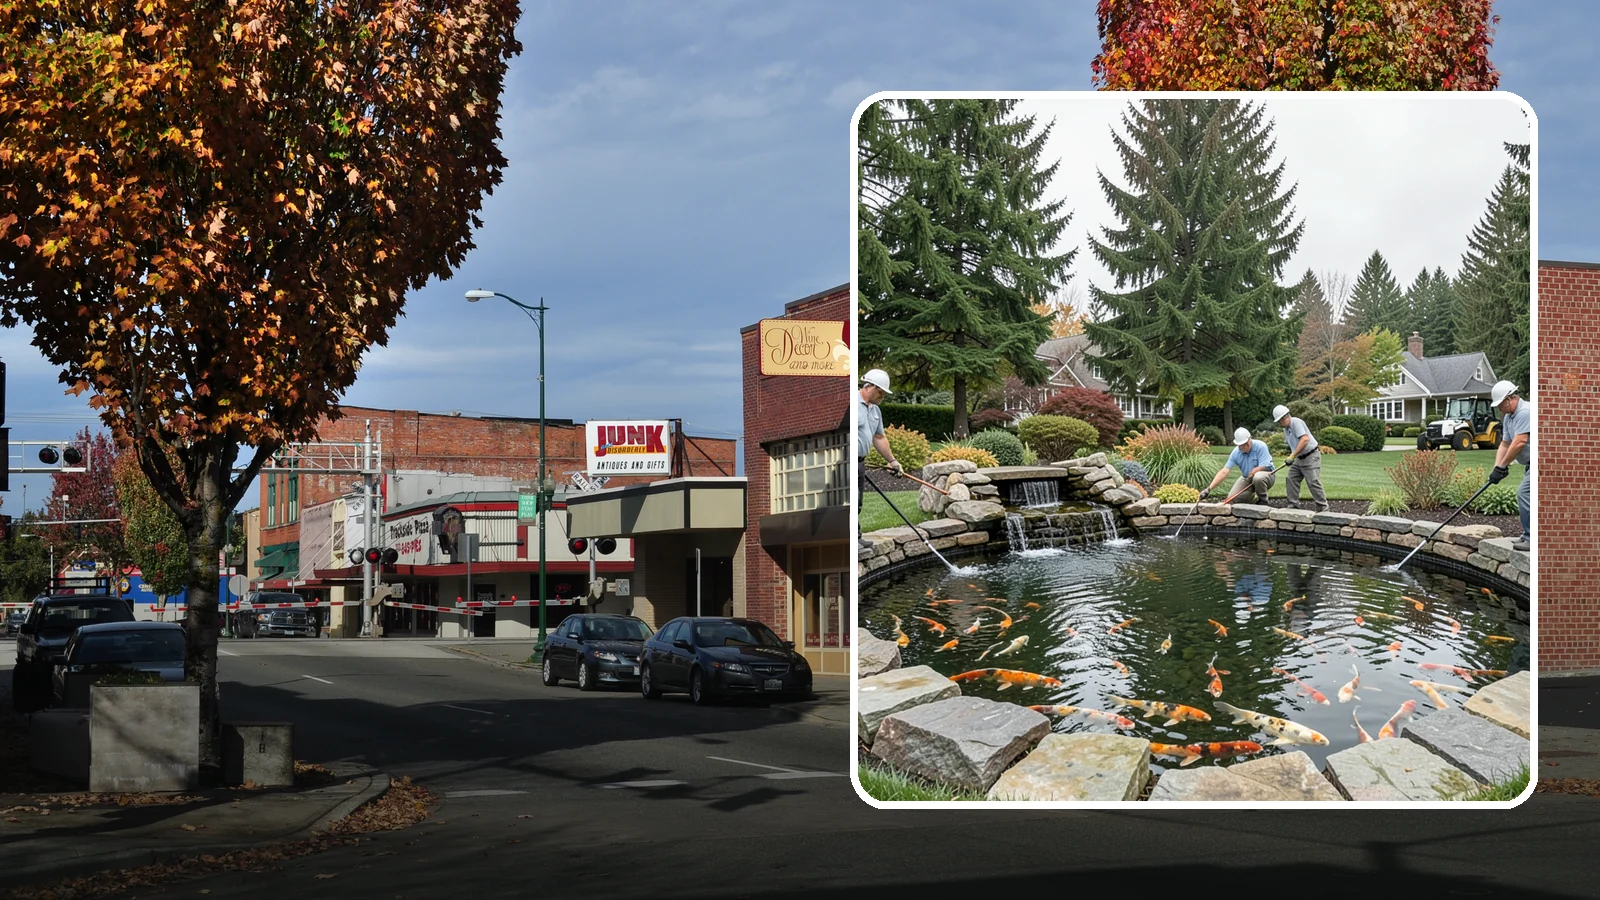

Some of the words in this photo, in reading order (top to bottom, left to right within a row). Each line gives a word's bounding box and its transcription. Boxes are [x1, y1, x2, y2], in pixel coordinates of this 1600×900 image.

[595, 425, 665, 457] JUNK
[607, 446, 646, 454] DISORDERLY
[596, 461, 628, 470] ANTIQUES
[631, 461, 644, 469] AND
[647, 460, 665, 469] GIFTS
[414, 519, 429, 535] Pizza
